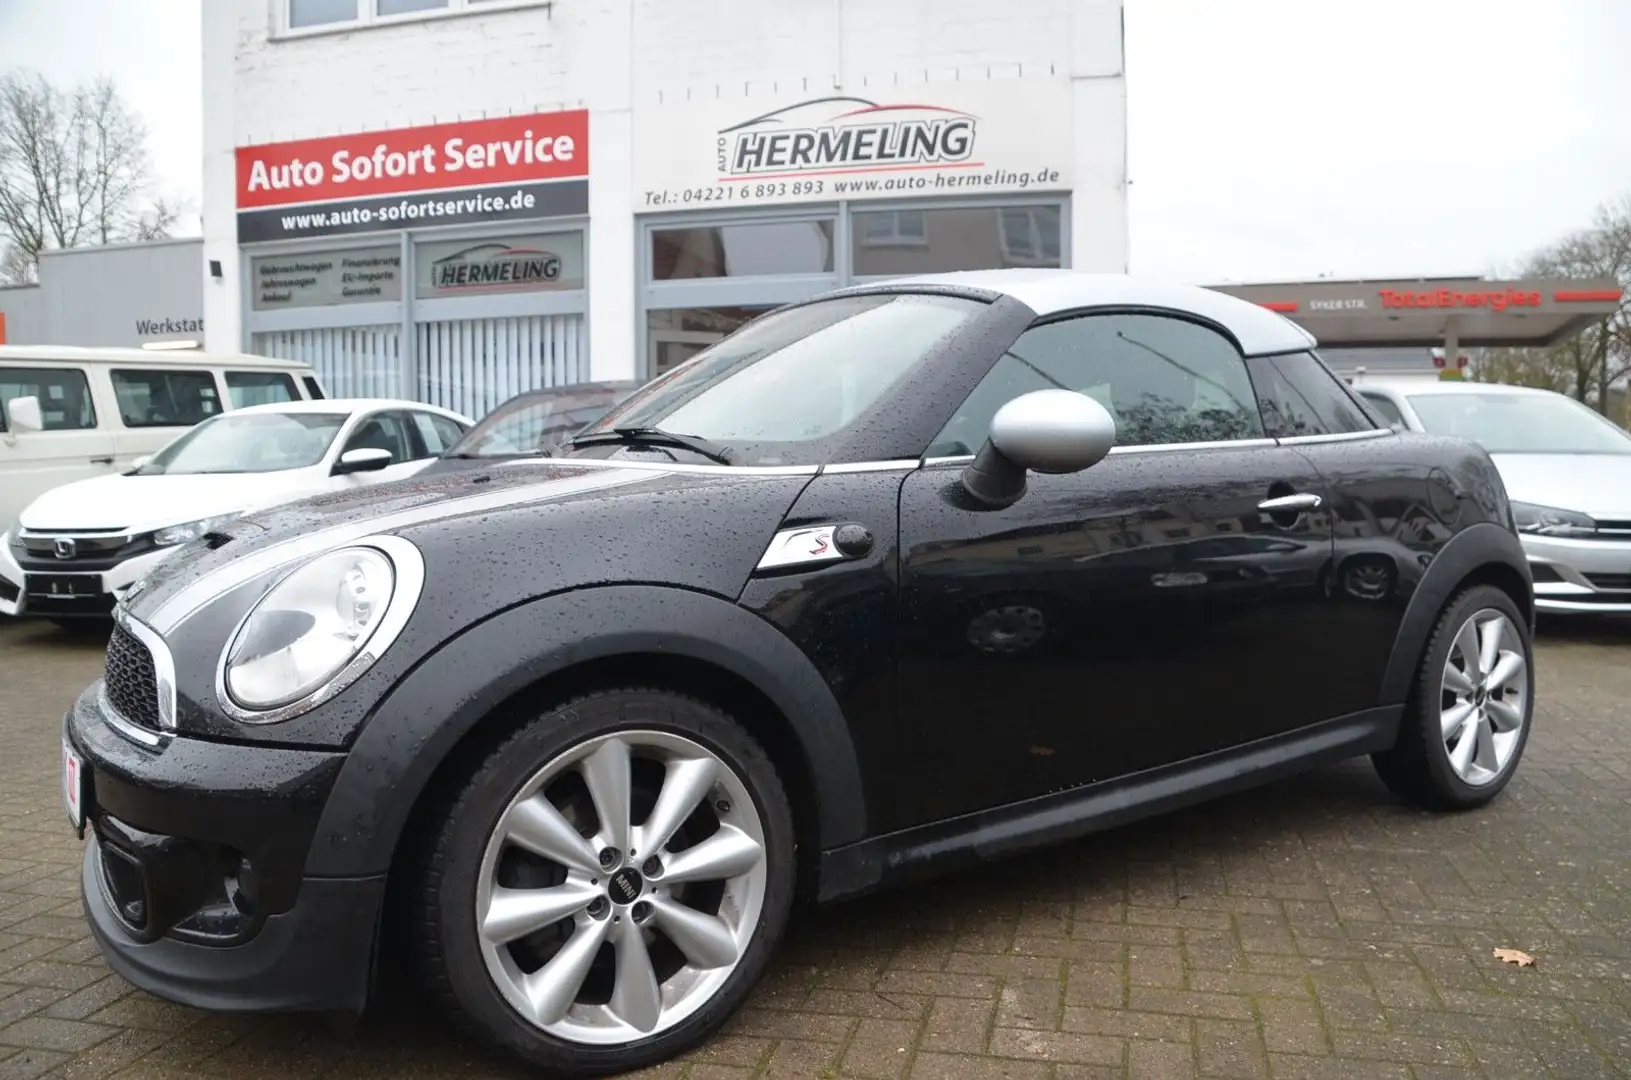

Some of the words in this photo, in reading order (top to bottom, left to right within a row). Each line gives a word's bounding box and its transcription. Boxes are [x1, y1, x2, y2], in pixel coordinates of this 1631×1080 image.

[248, 160, 324, 192] Auto
[331, 143, 436, 184] Sofort
[444, 129, 575, 173] Service
[717, 137, 727, 172] AUTO
[735, 118, 971, 170] HERMELING
[682, 187, 733, 204] 04221
[740, 185, 750, 199] 6
[755, 182, 786, 198] 893
[792, 180, 823, 196] 893
[834, 168, 1060, 194] www.auto-hermeling.de
[281, 190, 535, 230] www.auto-sofortservice.de
[441, 259, 558, 286] HERMELING
[1379, 287, 1541, 311] TotalEnergies
[615, 873, 637, 899] MINI
